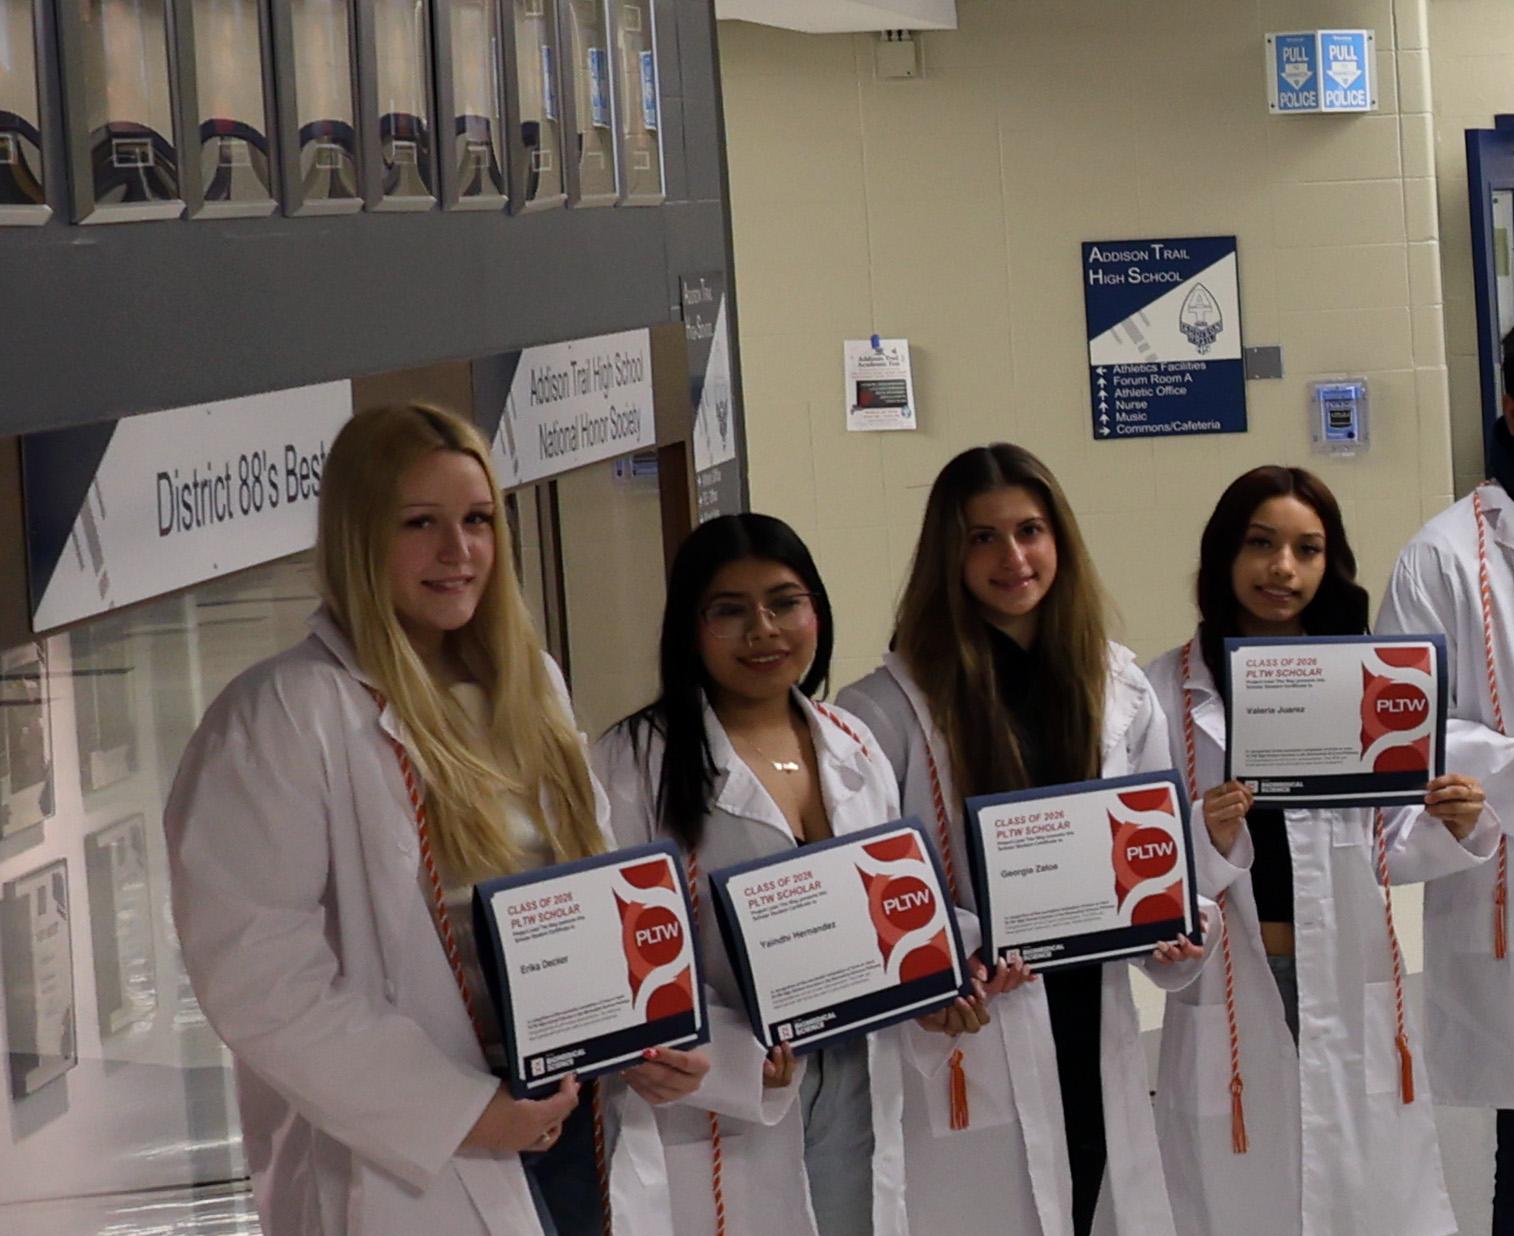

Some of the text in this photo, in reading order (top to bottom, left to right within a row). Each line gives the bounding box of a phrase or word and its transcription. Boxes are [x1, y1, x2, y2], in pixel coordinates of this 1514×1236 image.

[1283, 47, 1309, 61] PULL
[1328, 45, 1358, 60] PULL
[1280, 91, 1317, 107] POLICE
[1326, 90, 1366, 105] POLICE
[1089, 244, 1190, 263] ADDISON TRAIL
[1089, 267, 1183, 285] HIGH SCHOOL
[1113, 361, 1207, 374] Athletics Facilities
[530, 350, 643, 406] Addison Trail High School
[1113, 373, 1193, 386] Forum Room A
[1114, 385, 1187, 398] Athletic Office
[1116, 400, 1148, 410] Nurse
[1116, 412, 1148, 422] Music
[539, 402, 641, 460] National Honor Society
[1116, 420, 1221, 434] Commons/Cafeteria
[157, 461, 233, 537] District
[239, 450, 279, 517] 88's
[1246, 659, 1278, 667] CLASS
[1281, 658, 1294, 666] OF
[1246, 668, 1322, 678] PLTW SCHOLAR
[1377, 699, 1425, 713] PLTW
[995, 816, 1026, 827] CLASS
[1028, 814, 1041, 822] OF
[997, 821, 1070, 838] PLTW SCHOLAR
[1127, 842, 1173, 861] PLTW
[744, 881, 775, 896] CLASS
[778, 877, 790, 887] OF
[749, 895, 774, 909] PLTW
[777, 881, 821, 900] SCHOLAR
[883, 889, 929, 915] PLTW
[507, 900, 537, 915] CLASS
[539, 897, 551, 908] OF
[511, 904, 581, 928] PLTW SCHOLAR
[635, 922, 679, 946] PLTW
